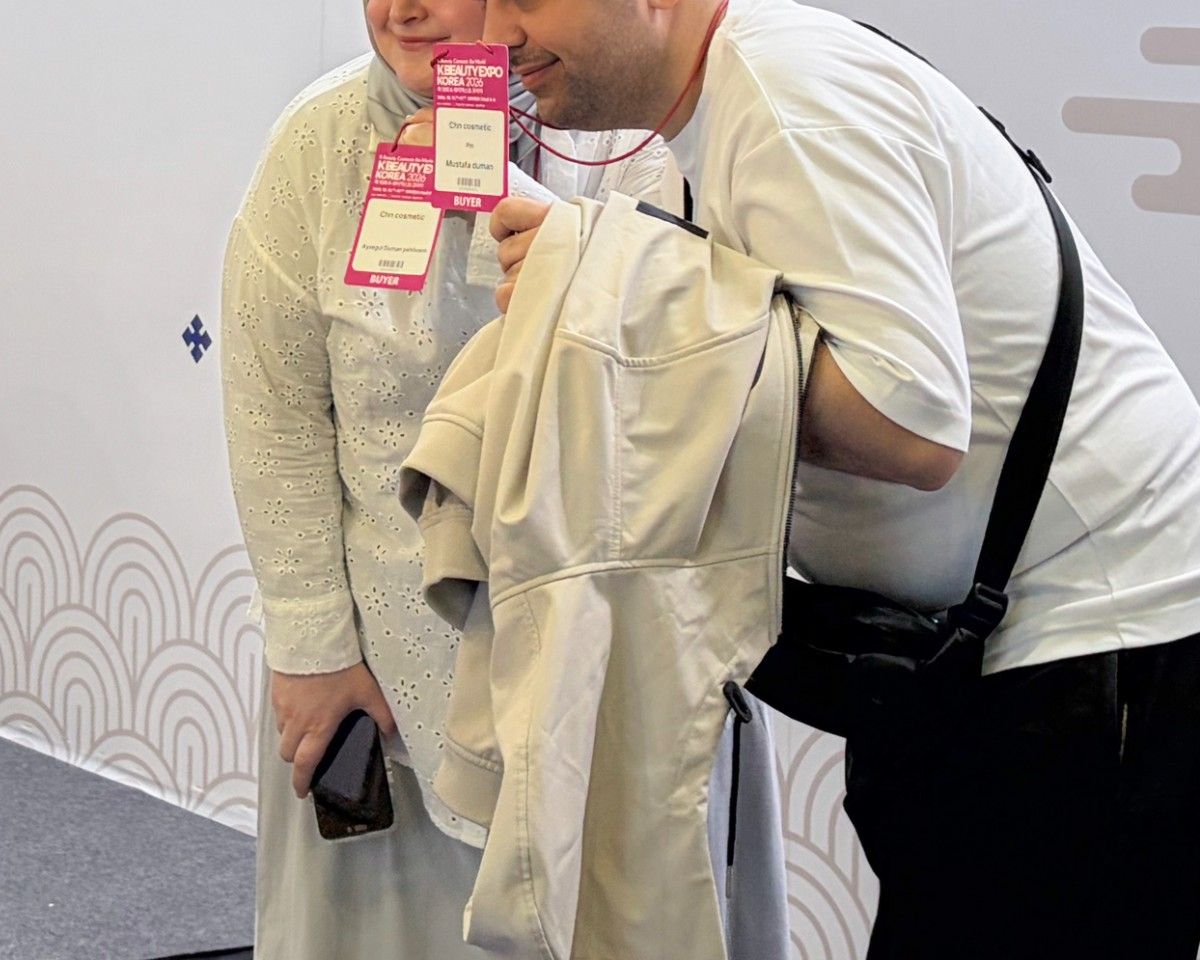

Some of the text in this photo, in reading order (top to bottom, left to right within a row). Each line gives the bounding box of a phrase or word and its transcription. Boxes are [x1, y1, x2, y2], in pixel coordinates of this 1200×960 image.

[436, 76, 465, 87] KOREA
[453, 195, 482, 208] BUYER
[369, 274, 400, 285] BUYER
